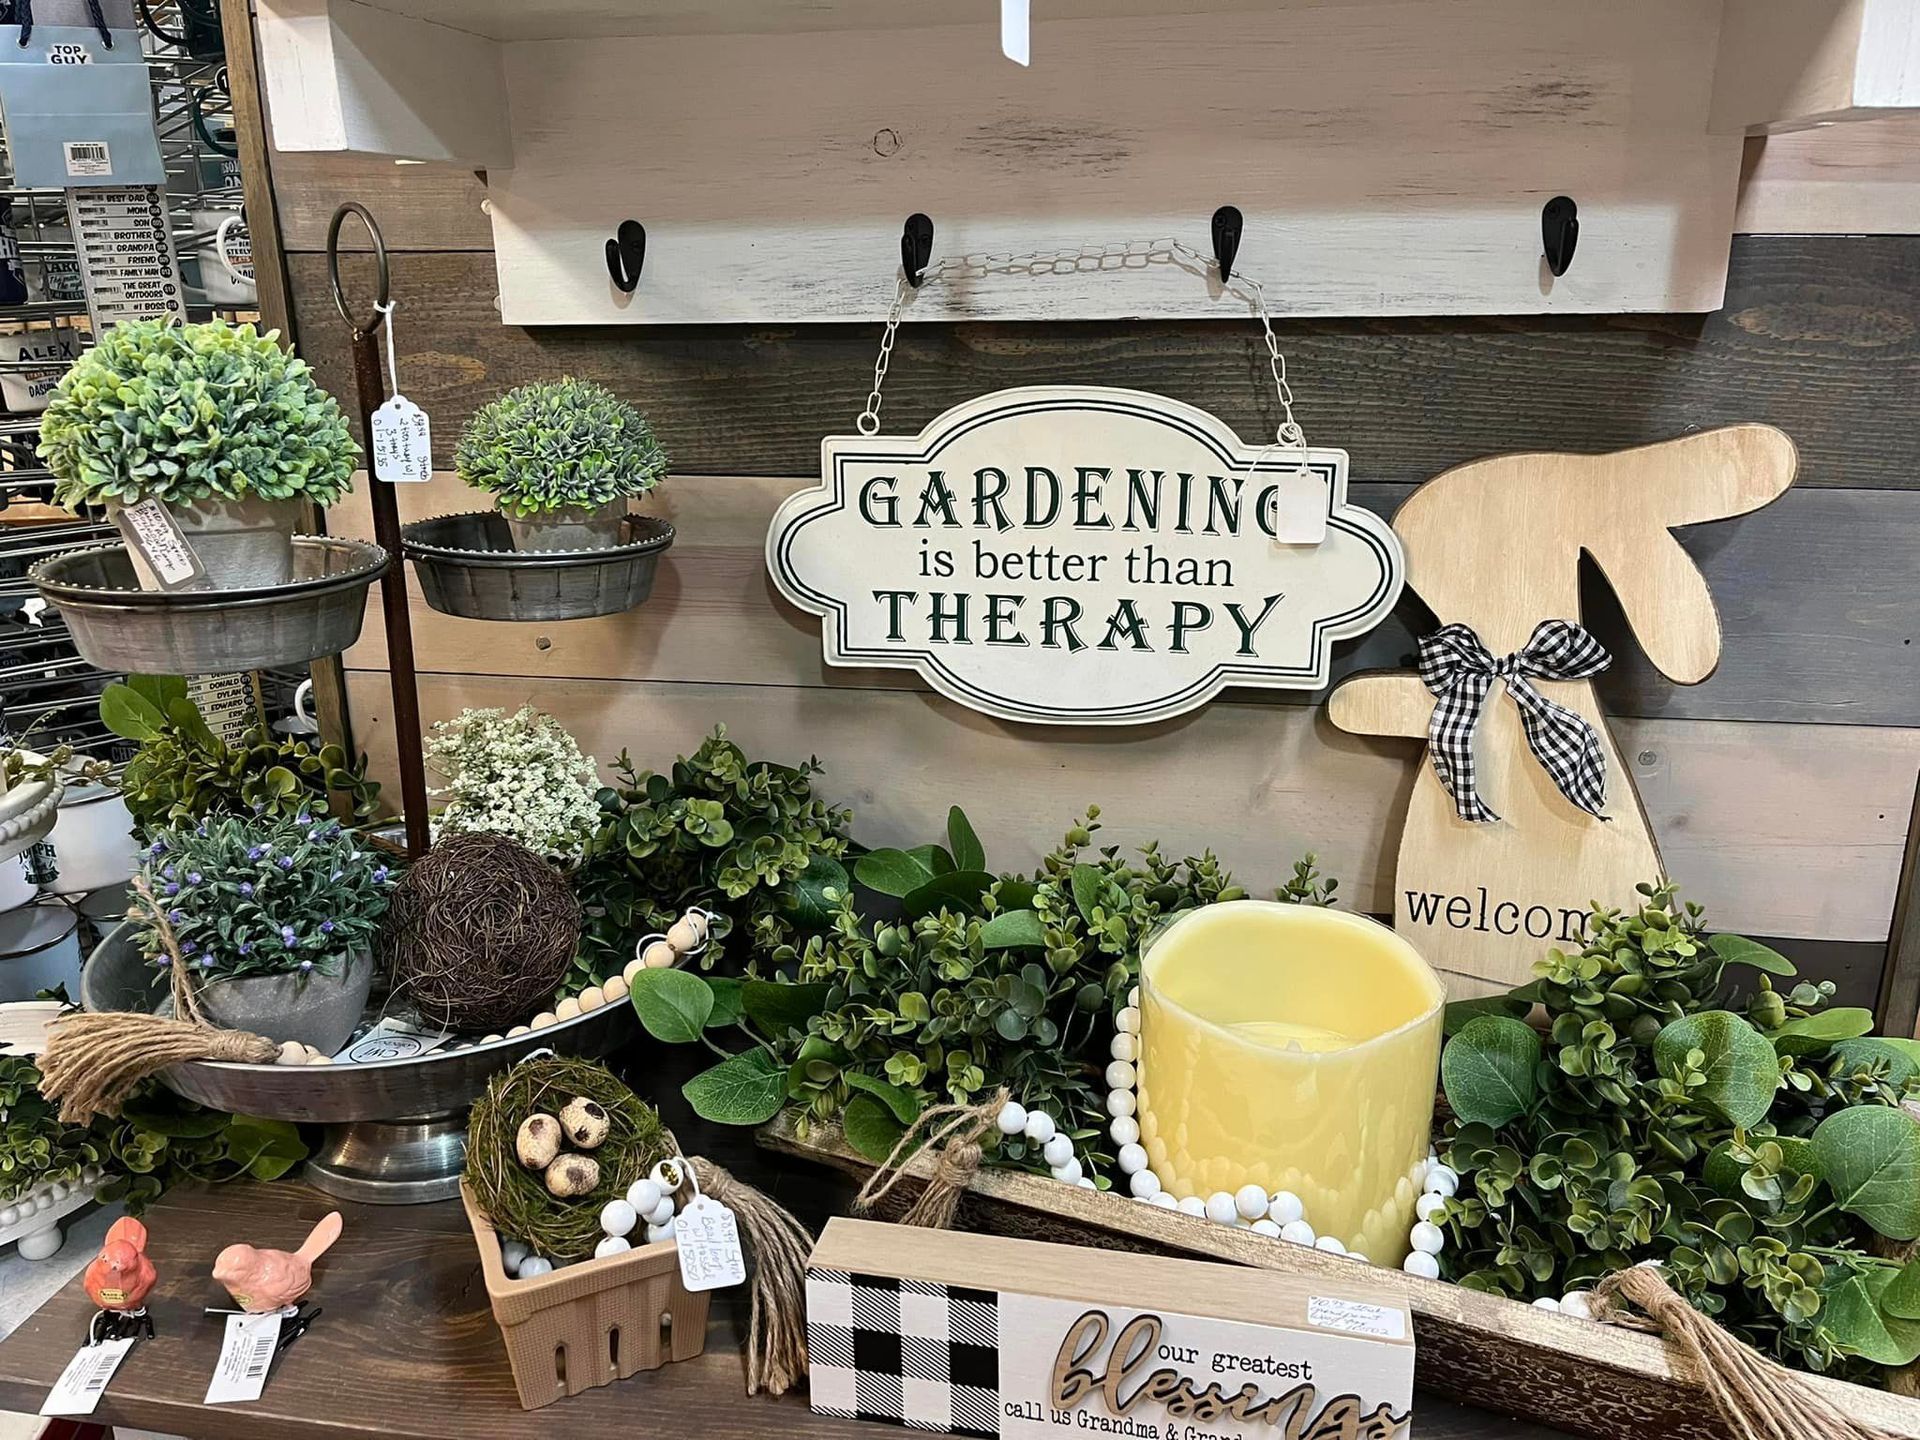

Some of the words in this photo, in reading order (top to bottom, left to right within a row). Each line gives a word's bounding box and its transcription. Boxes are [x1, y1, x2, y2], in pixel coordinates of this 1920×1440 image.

[54, 45, 81, 55] TOP
[51, 54, 87, 65] GUY
[128, 194, 145, 202] DAD
[127, 207, 148, 215] MOM
[133, 219, 150, 227] SON
[114, 231, 152, 240] BROTHER
[117, 243, 155, 252] GRANDPA
[128, 256, 156, 264] FRIEND
[122, 282, 136, 290] THE
[138, 281, 161, 289] GREAT
[125, 290, 163, 299] OUTDOORS
[144, 302, 166, 310] BOSS
[18, 342, 75, 361] ALEX
[919, 538, 954, 578] is
[971, 539, 1108, 582] better
[1125, 544, 1234, 587] than
[872, 590, 1286, 657] THERAPY
[209, 678, 239, 690] DONALD
[216, 688, 242, 699] DYLAN
[211, 699, 243, 711] EDWARD
[1404, 887, 1612, 944] welcom
[1157, 1344, 1199, 1364] our
[1211, 1352, 1313, 1381] greatest
[1052, 1309, 1413, 1440] blessings
[1004, 1401, 1045, 1422] call
[1050, 1408, 1071, 1426] us
[1077, 1409, 1160, 1440] Grandma
[1165, 1423, 1179, 1440] &
